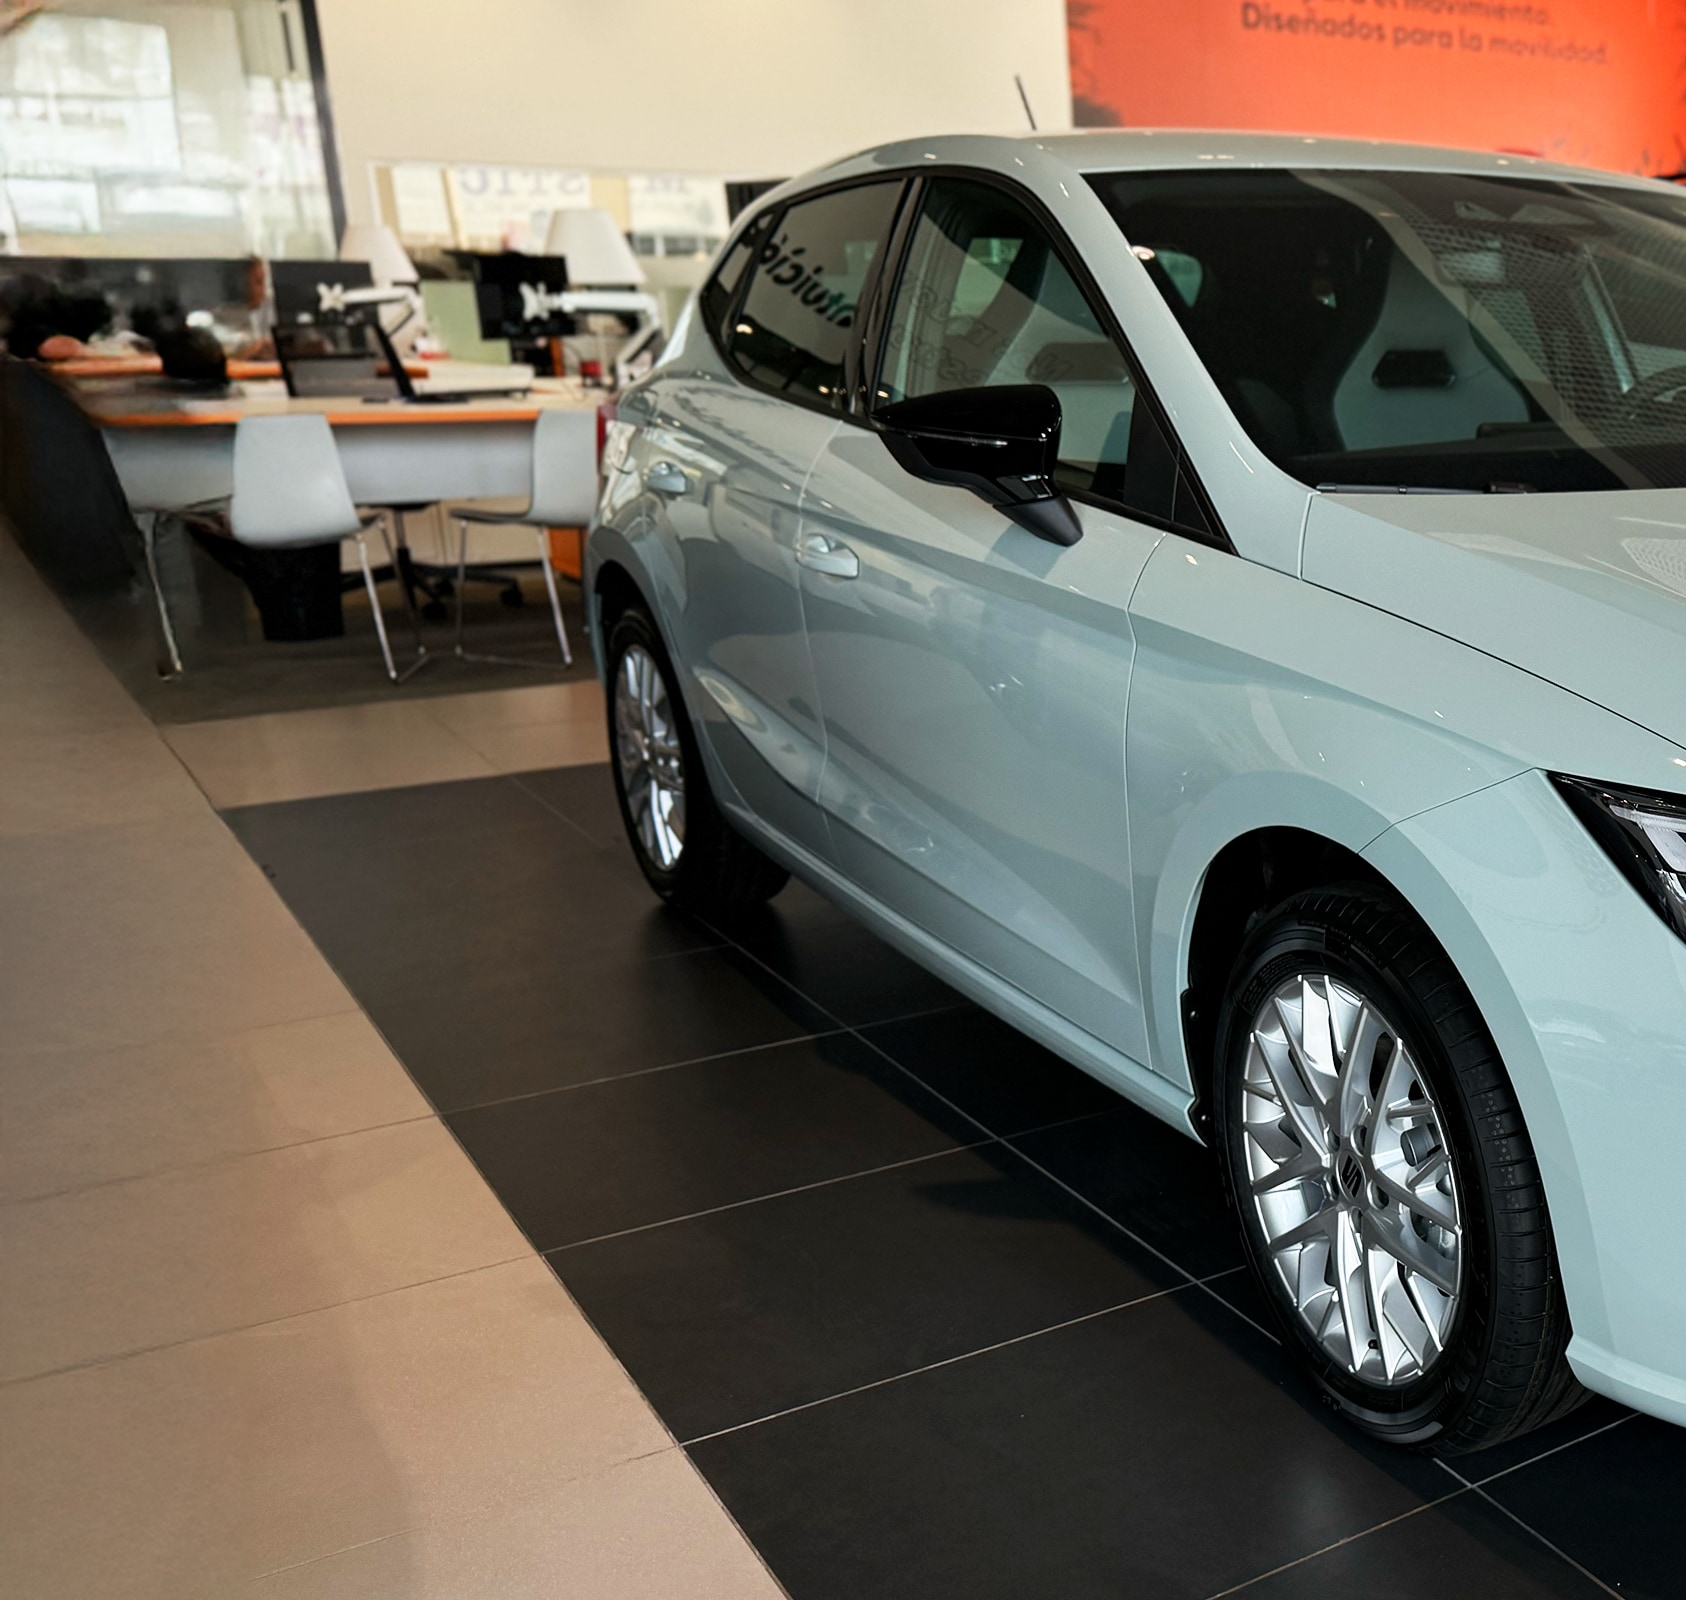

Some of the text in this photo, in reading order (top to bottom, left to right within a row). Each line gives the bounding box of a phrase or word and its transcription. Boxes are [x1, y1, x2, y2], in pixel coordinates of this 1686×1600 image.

[1241, 2, 1386, 41] Diseñados
[1393, 25, 1453, 47] para
[1458, 27, 1483, 51] la
